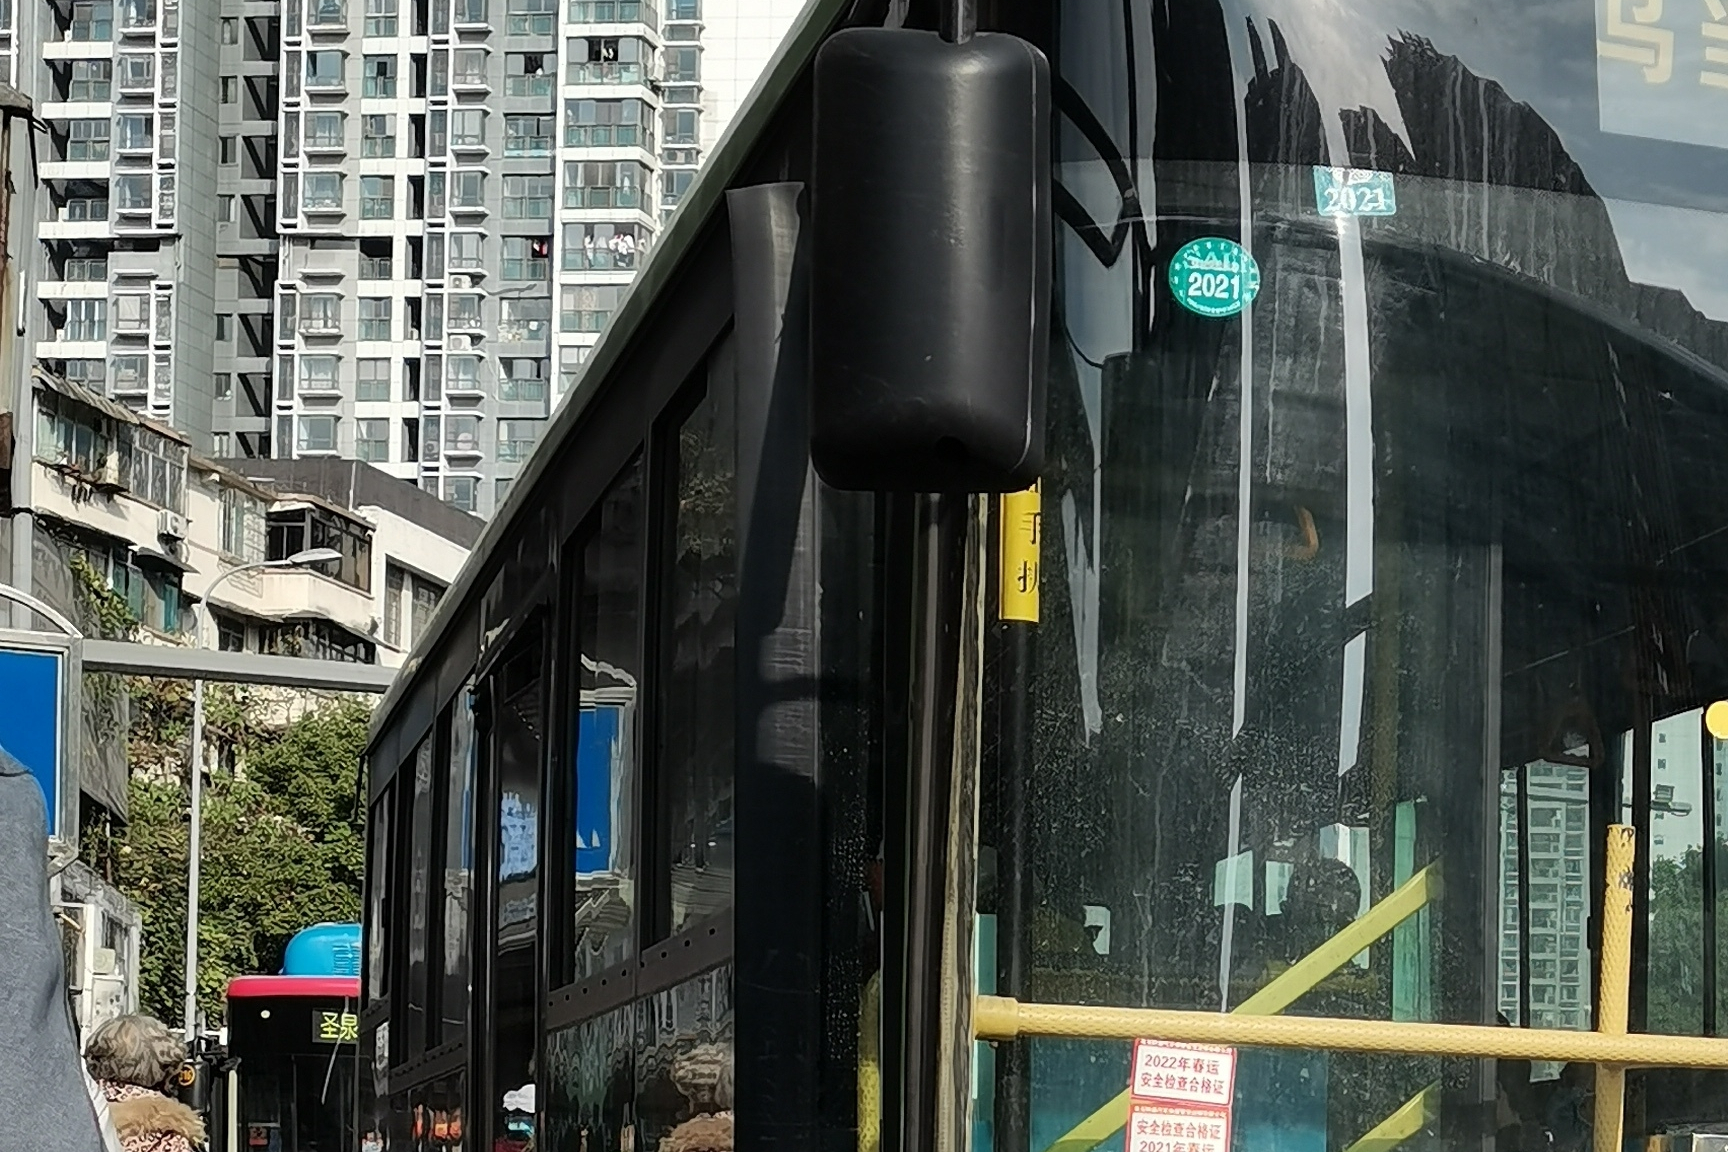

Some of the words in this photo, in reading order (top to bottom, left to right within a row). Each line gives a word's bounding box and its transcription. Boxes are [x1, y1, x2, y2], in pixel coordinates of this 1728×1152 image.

[1187, 271, 1240, 300] 2021
[1144, 1053, 1220, 1076] 2022年春运
[1140, 1072, 1225, 1096] 安全检查合格证
[1136, 1118, 1222, 1140] 安全检查合格证
